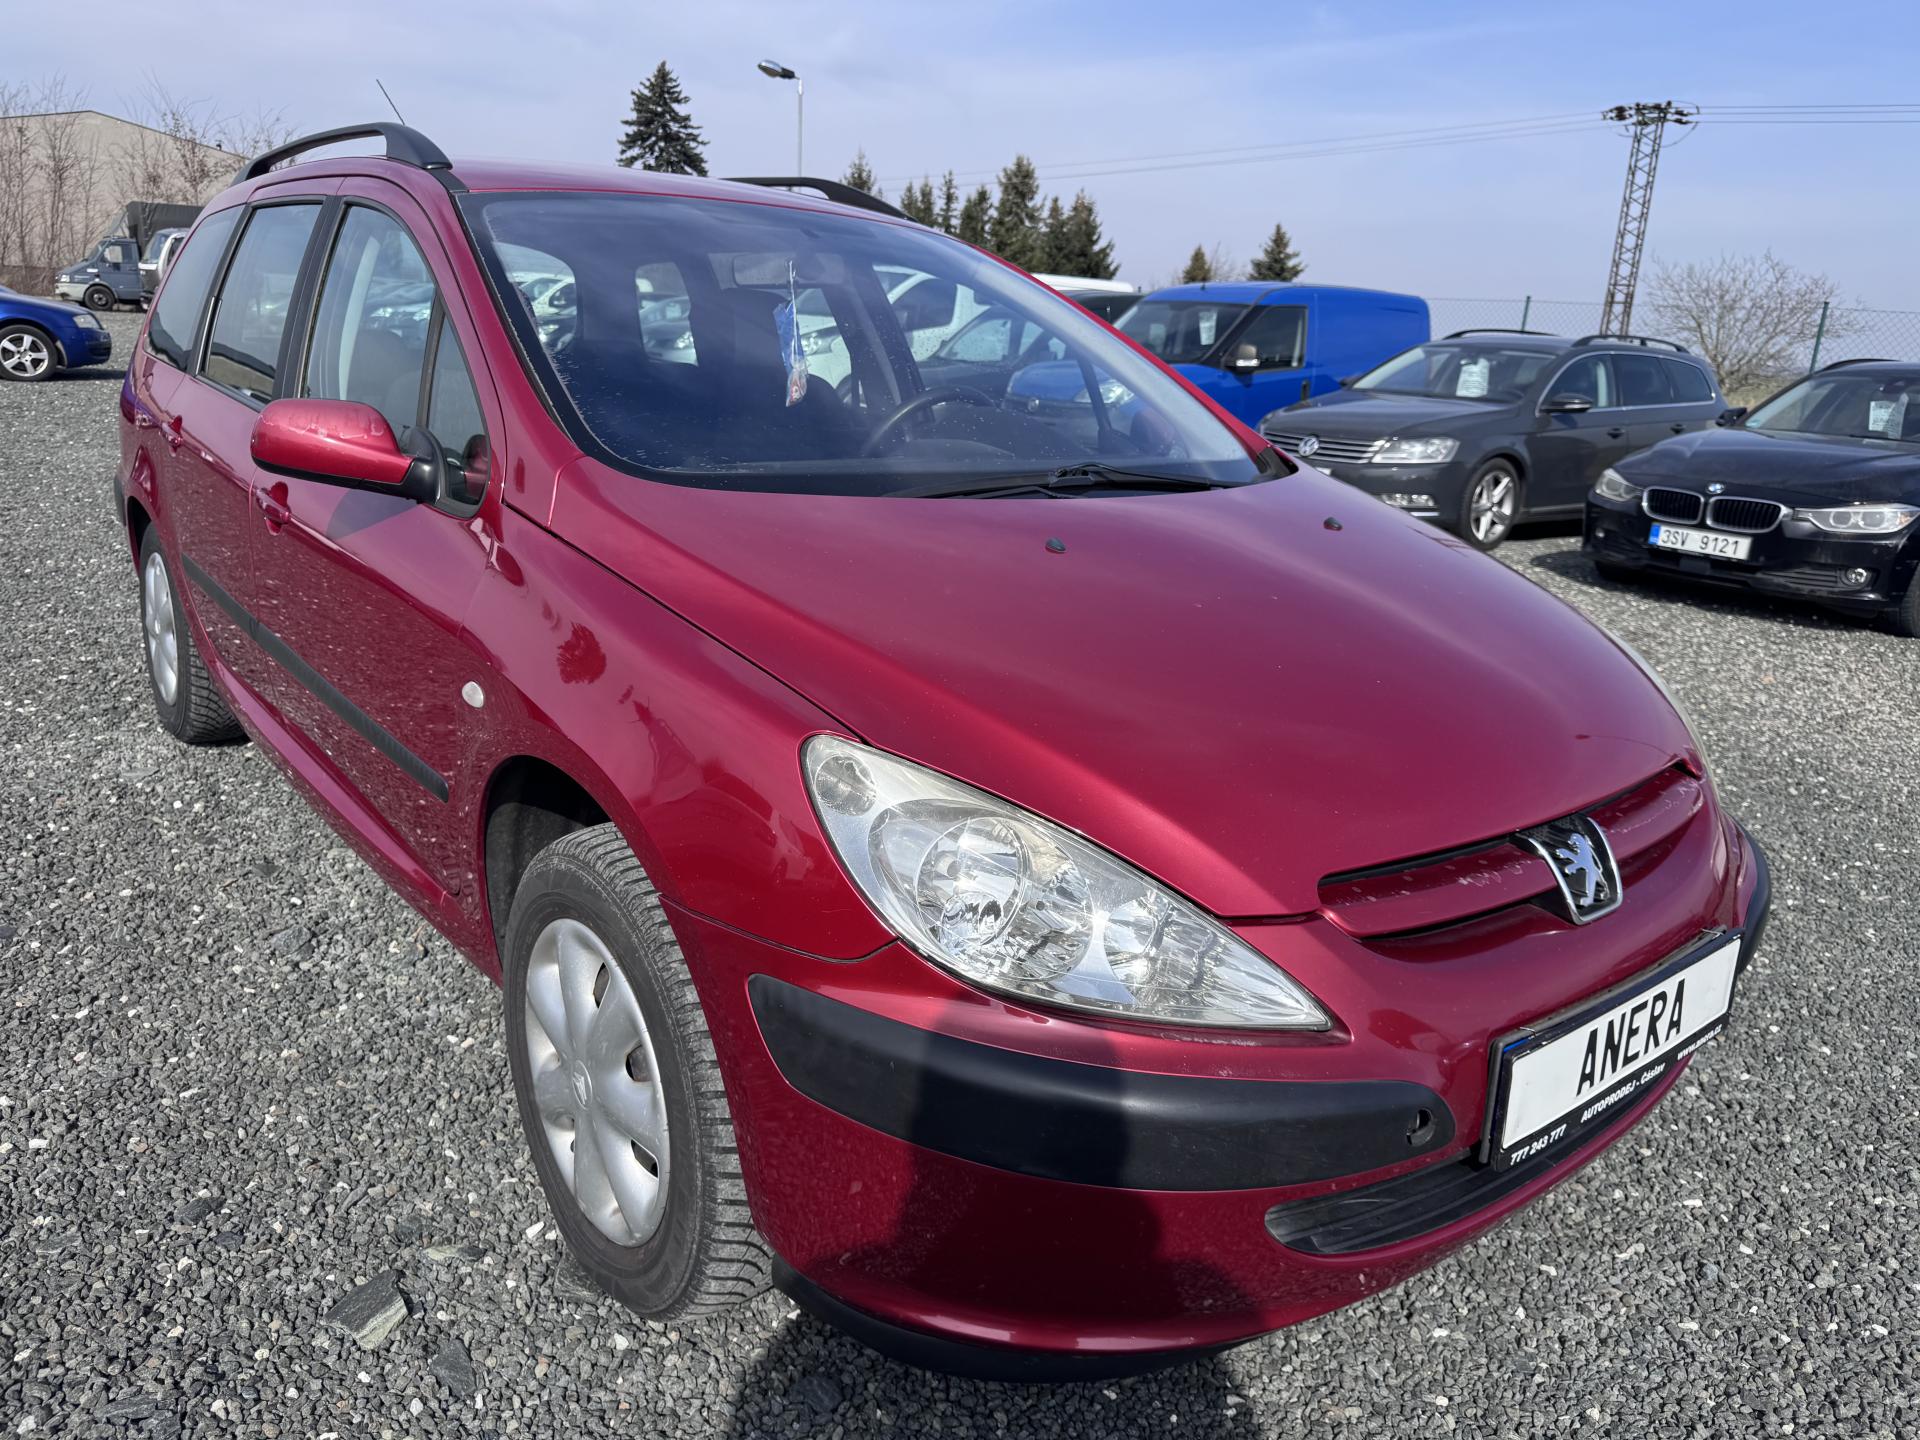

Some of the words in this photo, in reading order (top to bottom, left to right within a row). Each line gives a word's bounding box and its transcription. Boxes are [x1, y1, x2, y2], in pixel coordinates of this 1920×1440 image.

[1661, 529, 1689, 547] 3SV
[1699, 535, 1739, 555] 9121
[1576, 979, 1685, 1097] ANERA
[1510, 1145, 1530, 1166] 777
[1549, 1123, 1567, 1143] 777
[1580, 1080, 1636, 1123] AUTOPRODEJ
